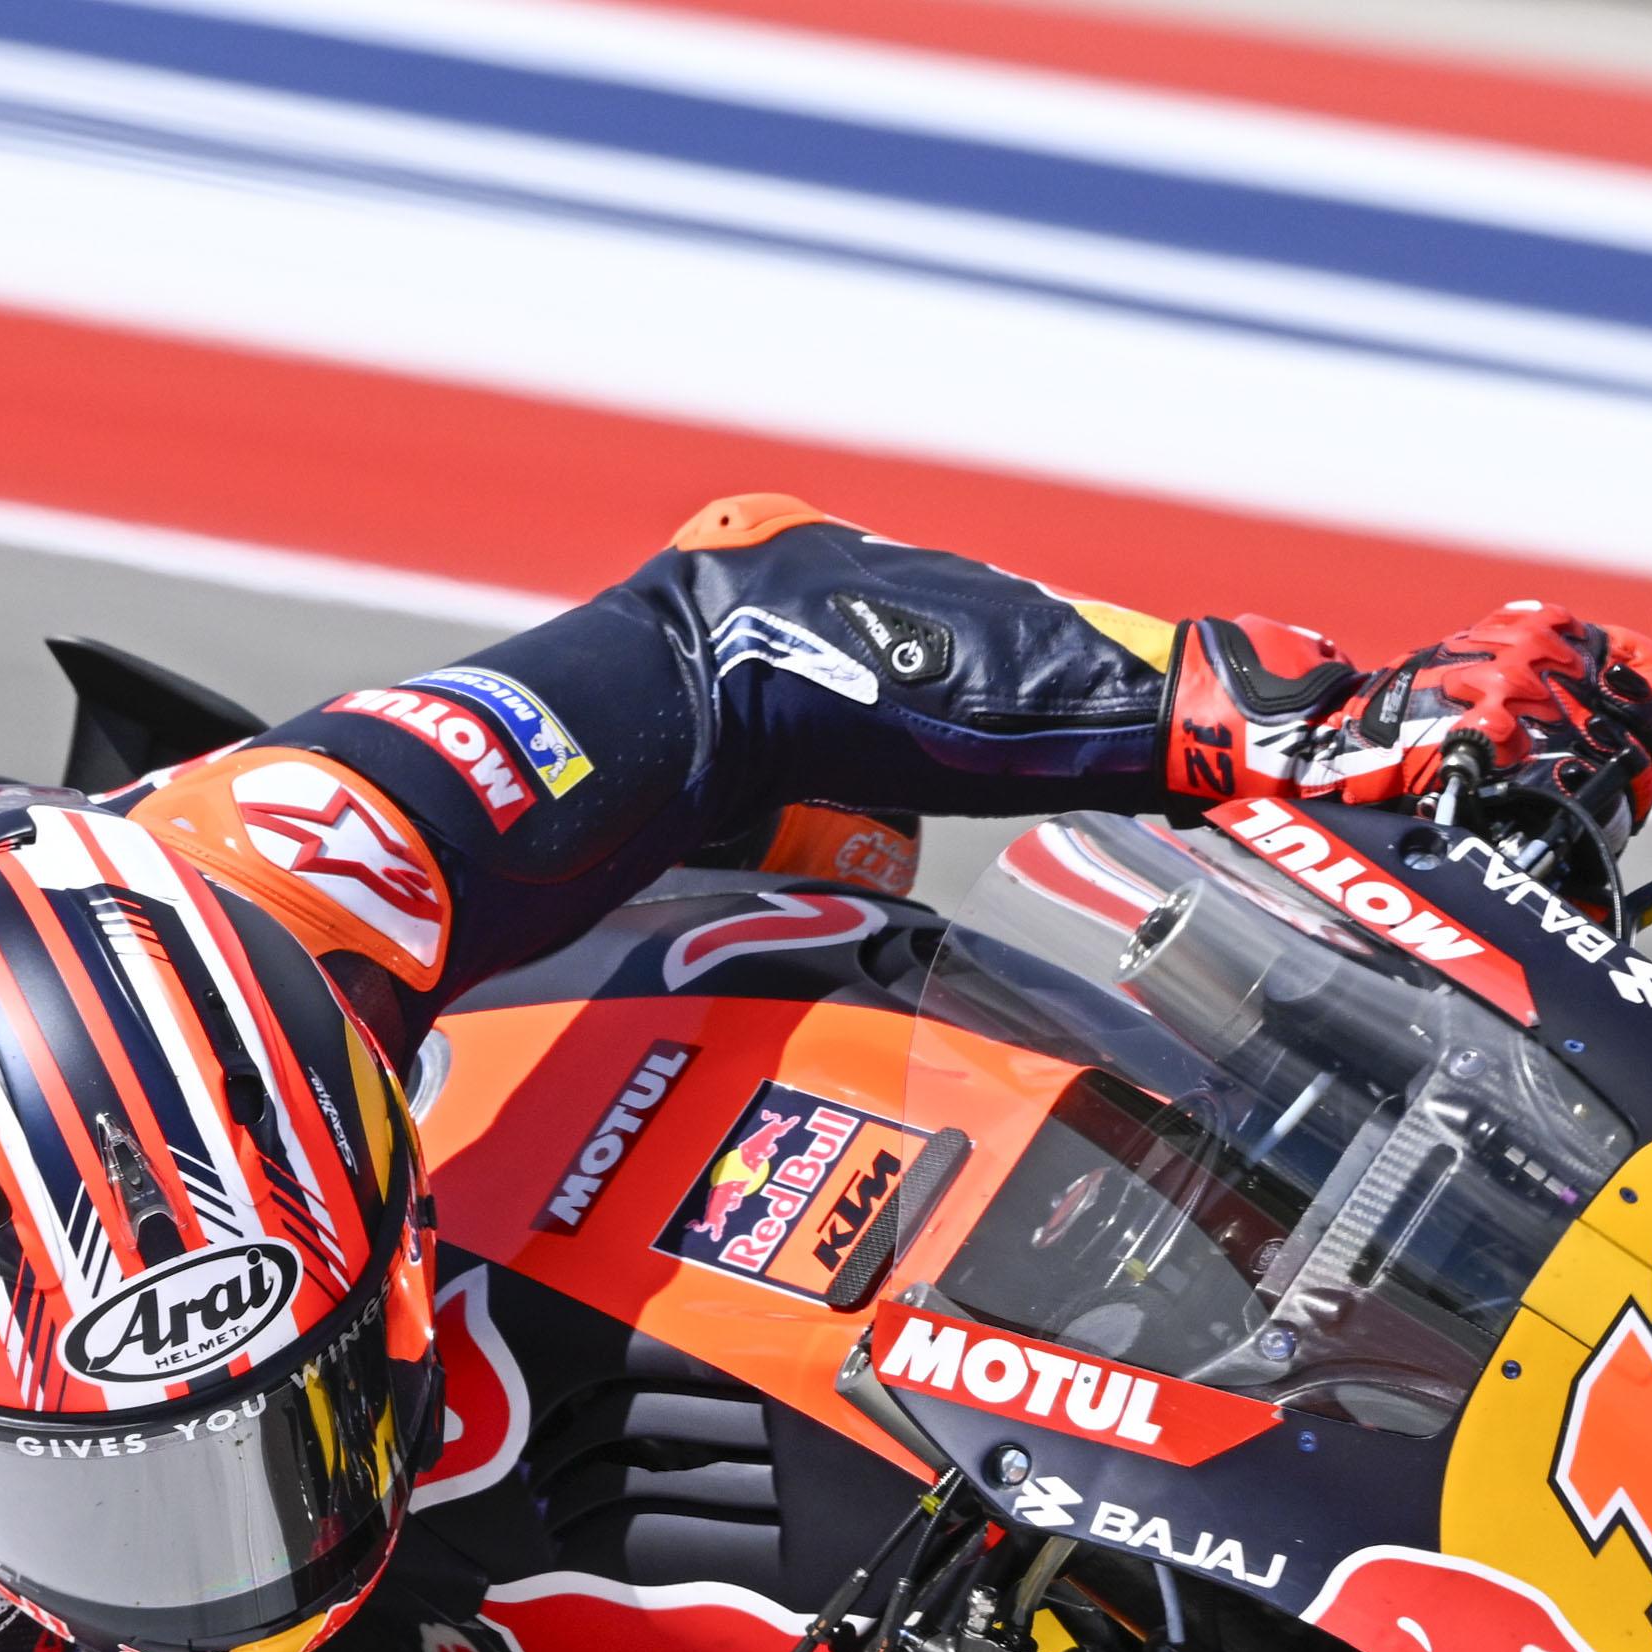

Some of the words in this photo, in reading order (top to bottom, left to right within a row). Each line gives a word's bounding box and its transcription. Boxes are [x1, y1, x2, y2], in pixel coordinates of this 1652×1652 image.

[344, 689, 525, 809] MOTUL
[1183, 716, 1237, 797] 12
[1227, 798, 1485, 960] MOTUL
[1447, 836, 1617, 964] BAJAJ
[548, 1049, 689, 1228] MOTUL
[717, 1164, 801, 1274] Red
[792, 1105, 860, 1195] Bull
[811, 1149, 902, 1273] KTM
[15, 1432, 148, 1459] GIVES
[172, 1392, 268, 1442] YOU
[289, 1275, 395, 1390] WINGS
[86, 1247, 277, 1373] Arai
[155, 1325, 242, 1370] HELMET
[879, 1316, 1164, 1446] MOTUL
[1089, 1501, 1288, 1590] BAJAJ
